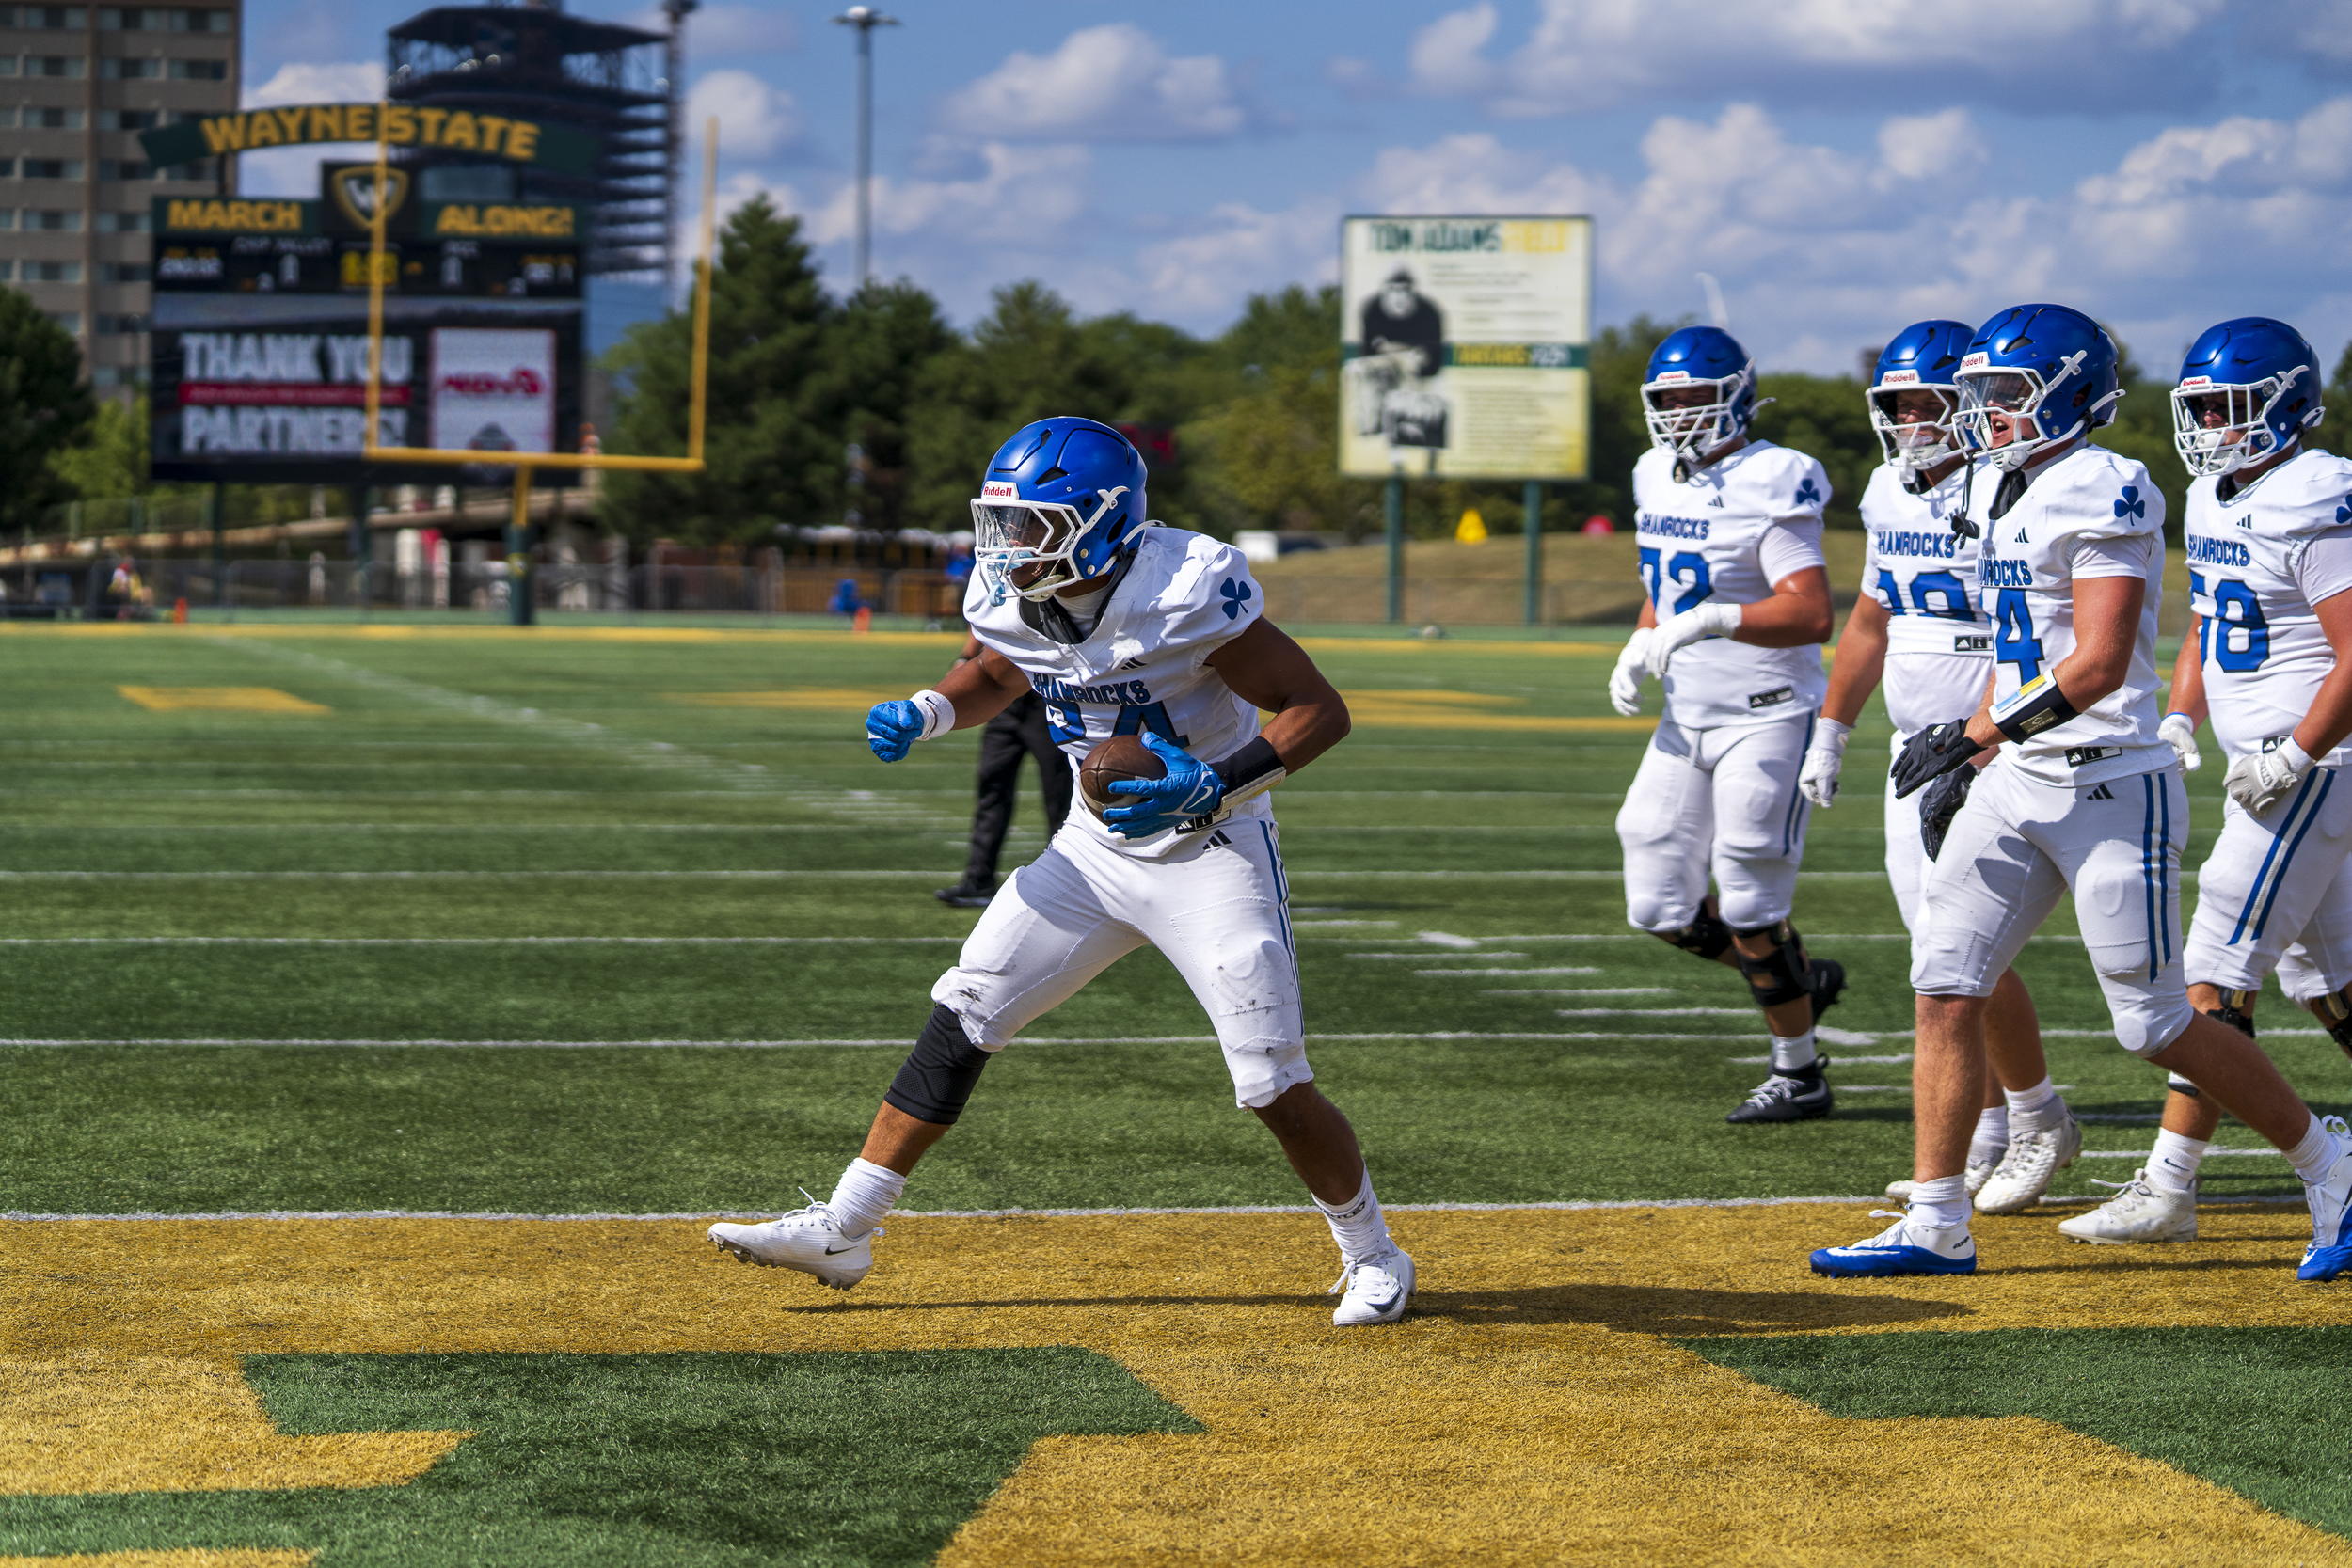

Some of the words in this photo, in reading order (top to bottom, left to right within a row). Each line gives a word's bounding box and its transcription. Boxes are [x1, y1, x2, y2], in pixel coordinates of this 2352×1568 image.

[200, 105, 374, 154] WAYNE
[386, 107, 542, 161] STATE
[167, 200, 302, 230] MARCH
[179, 331, 322, 381] THANK
[325, 334, 413, 384] YOU
[1883, 373, 1915, 384] Riddell
[983, 485, 1012, 498] Riddell
[1877, 530, 1956, 559] HAMROCKS
